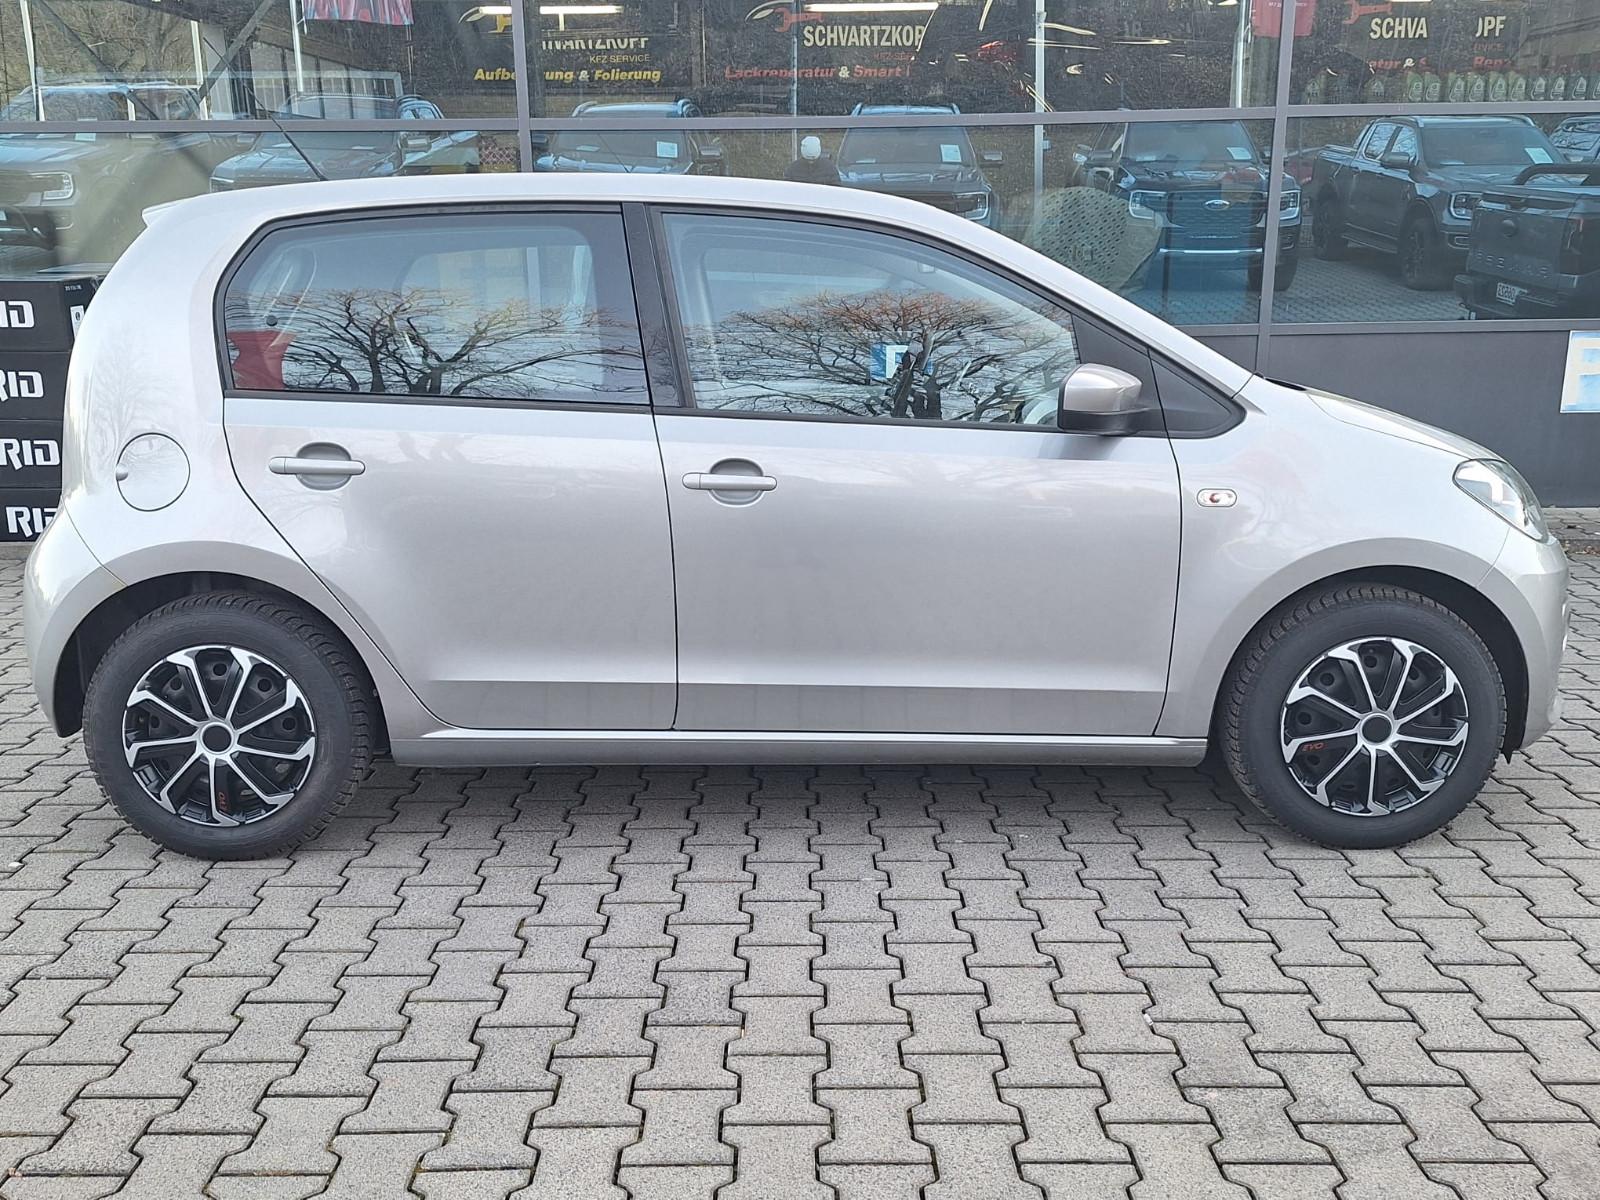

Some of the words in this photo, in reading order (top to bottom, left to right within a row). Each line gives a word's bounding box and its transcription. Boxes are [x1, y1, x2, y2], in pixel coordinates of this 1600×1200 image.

[610, 54, 650, 63] SERVICE
[579, 69, 590, 82] &
[595, 69, 661, 83] Folierung
[839, 66, 850, 78] &
